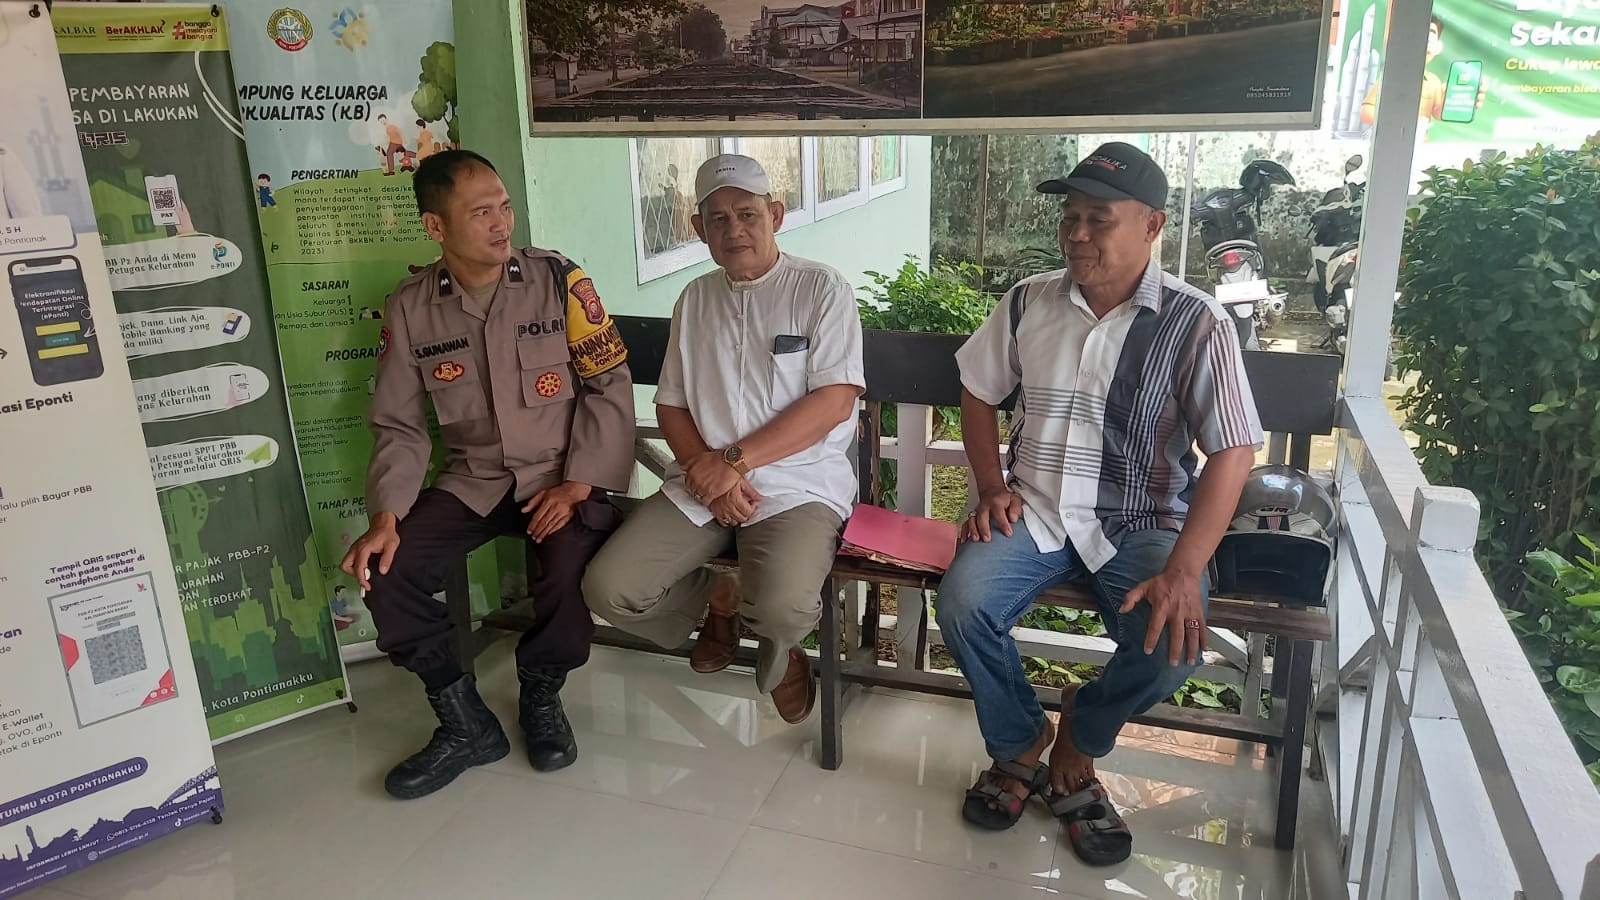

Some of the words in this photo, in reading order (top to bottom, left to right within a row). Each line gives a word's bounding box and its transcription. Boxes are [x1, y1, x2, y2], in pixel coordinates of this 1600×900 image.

[105, 20, 165, 35] BerAKHLAK
[69, 82, 190, 103] PEMBAYARAN
[301, 84, 388, 101] KELUARGA
[99, 108, 118, 123] DI
[123, 104, 200, 123] LAKUKAN
[331, 101, 372, 123] (KB)
[291, 169, 359, 181] PENGERTIAN
[334, 187, 372, 195] setingkat
[320, 195, 355, 205] terdapat
[358, 194, 393, 203] integrasi
[296, 204, 365, 214] penyelenggaraan
[297, 213, 340, 222] penguatan
[297, 221, 327, 230] seluruh
[4, 235, 48, 245] Pontianak
[298, 230, 331, 238] kualitas
[397, 227, 412, 235] dan
[134, 254, 158, 264] Anda
[160, 253, 170, 263] di
[172, 251, 197, 261] Menu
[108, 265, 146, 276] Petugas
[148, 260, 195, 271] Kelurahan
[24, 288, 76, 299] Elektronifikasi
[301, 279, 350, 292] SASARAN
[31, 303, 75, 313] Terintegrasi
[287, 310, 303, 319] Usia
[305, 309, 326, 318] Subur
[327, 308, 347, 317] (PUS)
[169, 315, 188, 325] Link
[517, 318, 565, 338] POLRI
[149, 325, 186, 337] Banking
[188, 322, 211, 333] yang
[123, 339, 135, 349] da
[138, 337, 164, 348] miliki
[414, 337, 470, 359] S.GUNAWAN
[160, 384, 210, 400] diberikan
[25, 391, 74, 411] Eponti
[158, 393, 212, 408] Kelurahan
[162, 451, 192, 461] sesuai
[194, 446, 215, 456] SPPT
[219, 441, 237, 450] PBB
[157, 459, 194, 471] Petugas
[197, 449, 244, 463] Kelurahan
[183, 462, 217, 475] melalui
[219, 456, 242, 468] QRIS
[20, 496, 40, 508] pilih
[42, 490, 71, 503] Bayar
[73, 484, 93, 496] PBB
[317, 498, 349, 511] TAHAP
[50, 561, 81, 575] Tampil
[82, 555, 105, 567] QRIS
[105, 546, 137, 561] seperti
[186, 556, 222, 570] PAJAK
[227, 544, 271, 562] PBB-P2
[44, 572, 77, 585] contoh
[78, 565, 101, 578] pada
[102, 557, 135, 572] gambar
[136, 553, 146, 562] di
[59, 573, 110, 590] handphone
[111, 565, 135, 577] Anda
[183, 602, 198, 613] AN
[201, 587, 254, 608] TERDEKAT
[211, 696, 239, 711] Kota
[243, 672, 314, 702] Pontianakku
[2, 712, 44, 731] E-Wallet
[20, 740, 30, 749] di
[32, 730, 63, 745] Eponti
[39, 790, 69, 805] KOTA
[70, 764, 142, 795] PONTIANAKKU
